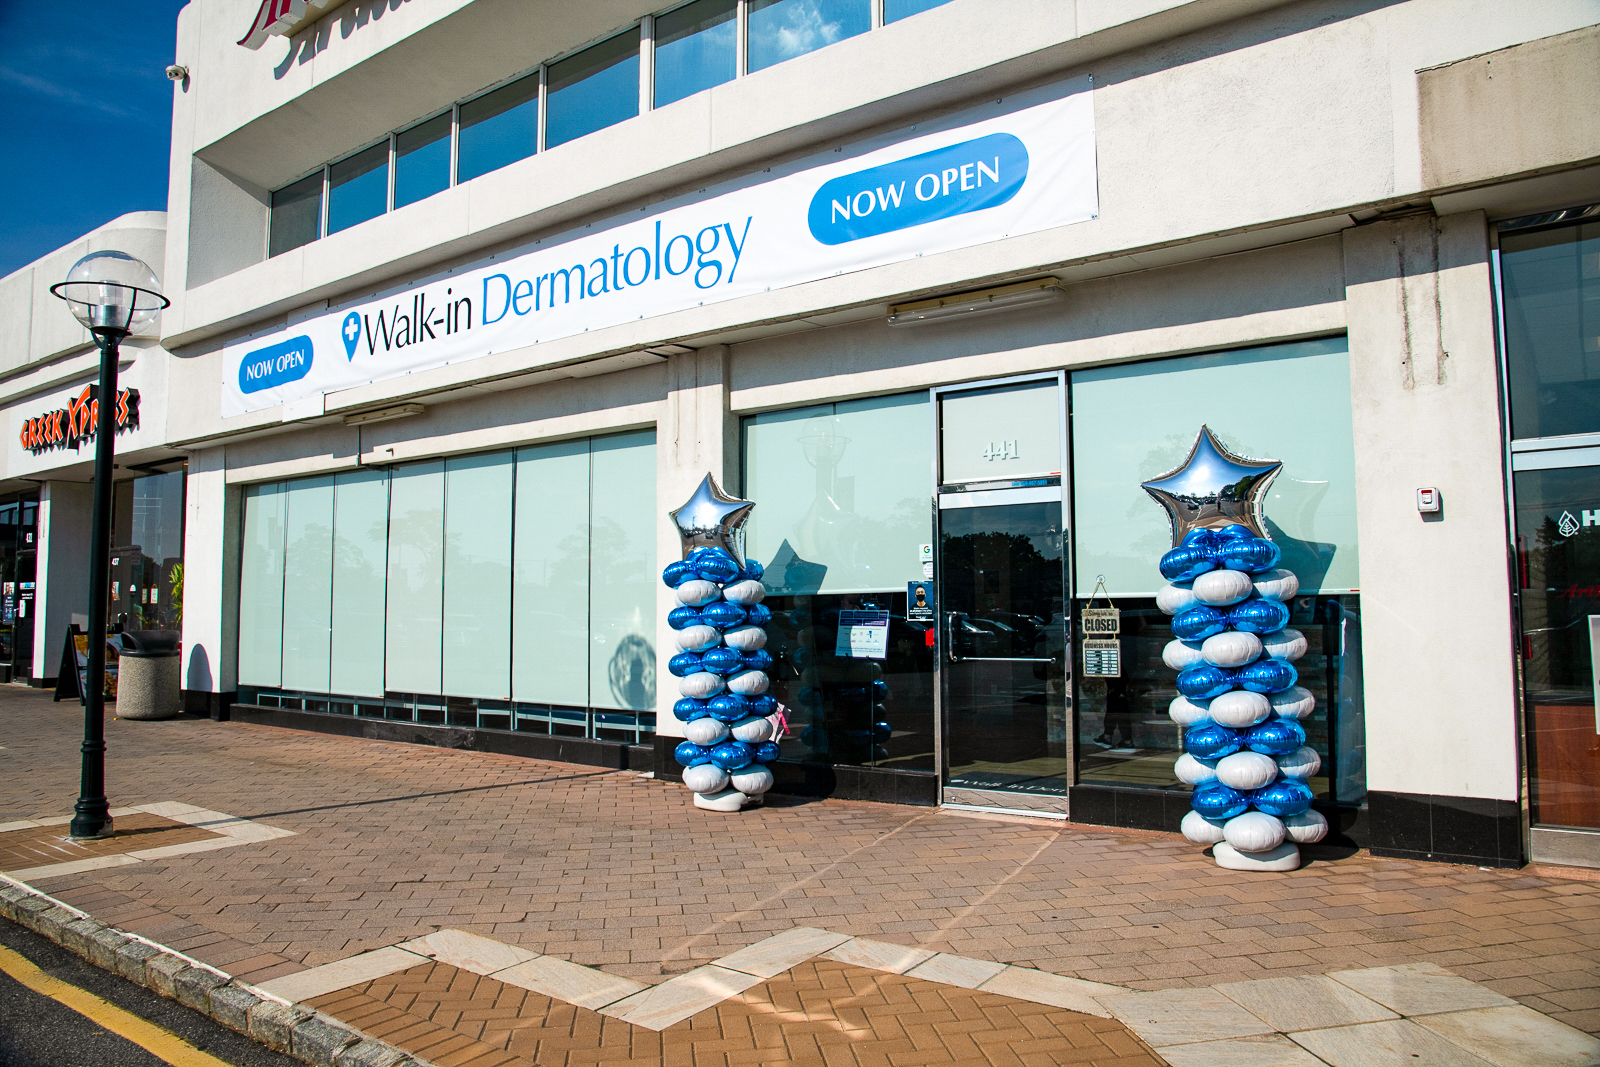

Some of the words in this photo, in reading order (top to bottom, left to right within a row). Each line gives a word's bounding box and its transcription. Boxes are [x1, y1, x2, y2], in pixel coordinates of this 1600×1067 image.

[831, 181, 906, 224] NOW
[914, 156, 1000, 202] OPEN
[364, 287, 472, 356] Walk-in
[482, 216, 753, 326] Dermatology
[246, 358, 275, 382] NOW
[276, 348, 305, 373] OPEN
[19, 409, 64, 450] GREEK
[983, 440, 1020, 461] 441
[1084, 618, 1117, 631] CLOSED
